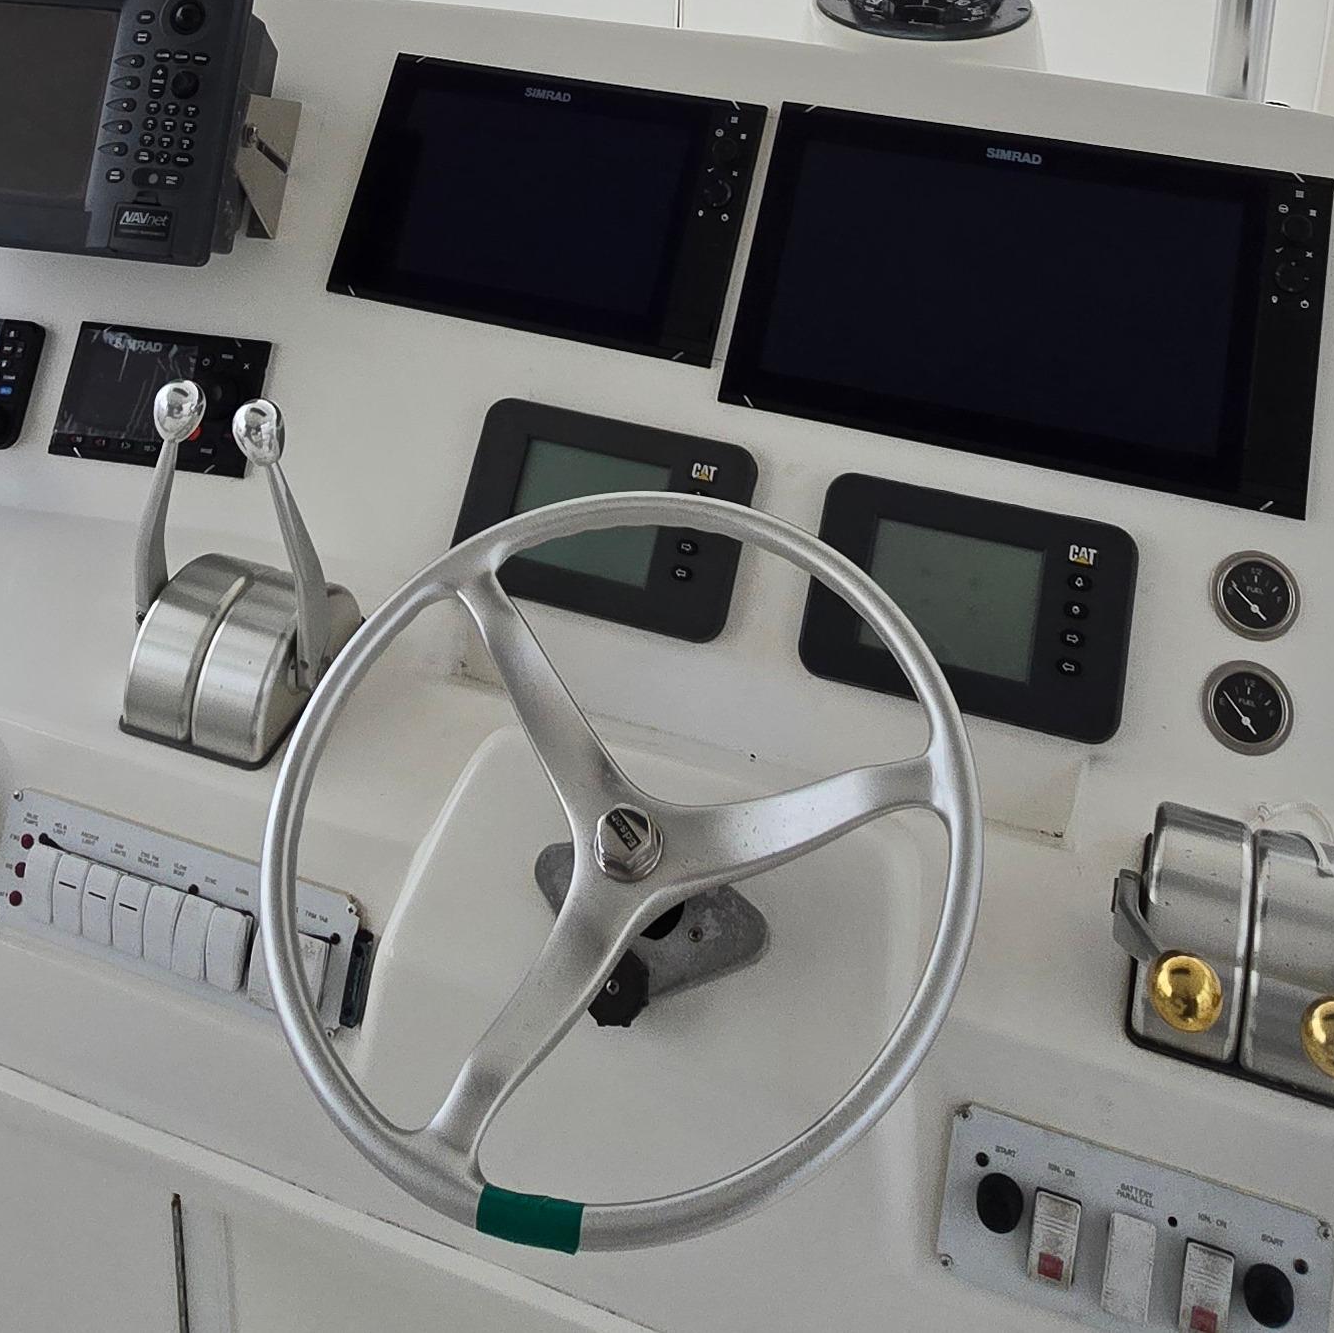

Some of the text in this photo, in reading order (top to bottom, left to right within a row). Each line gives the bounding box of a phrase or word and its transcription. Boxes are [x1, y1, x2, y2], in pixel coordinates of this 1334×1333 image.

[524, 87, 572, 103] SIMRAD
[986, 147, 1043, 166] SIMRAD
[118, 210, 170, 228] NAVnet
[692, 462, 719, 482] CAT
[1069, 544, 1098, 566] CAT
[1246, 585, 1264, 595] FUEL
[1238, 698, 1256, 707] FUEL
[1116, 1189, 1156, 1209] PARALLEL
[1119, 1182, 1154, 1199] BATTERY
